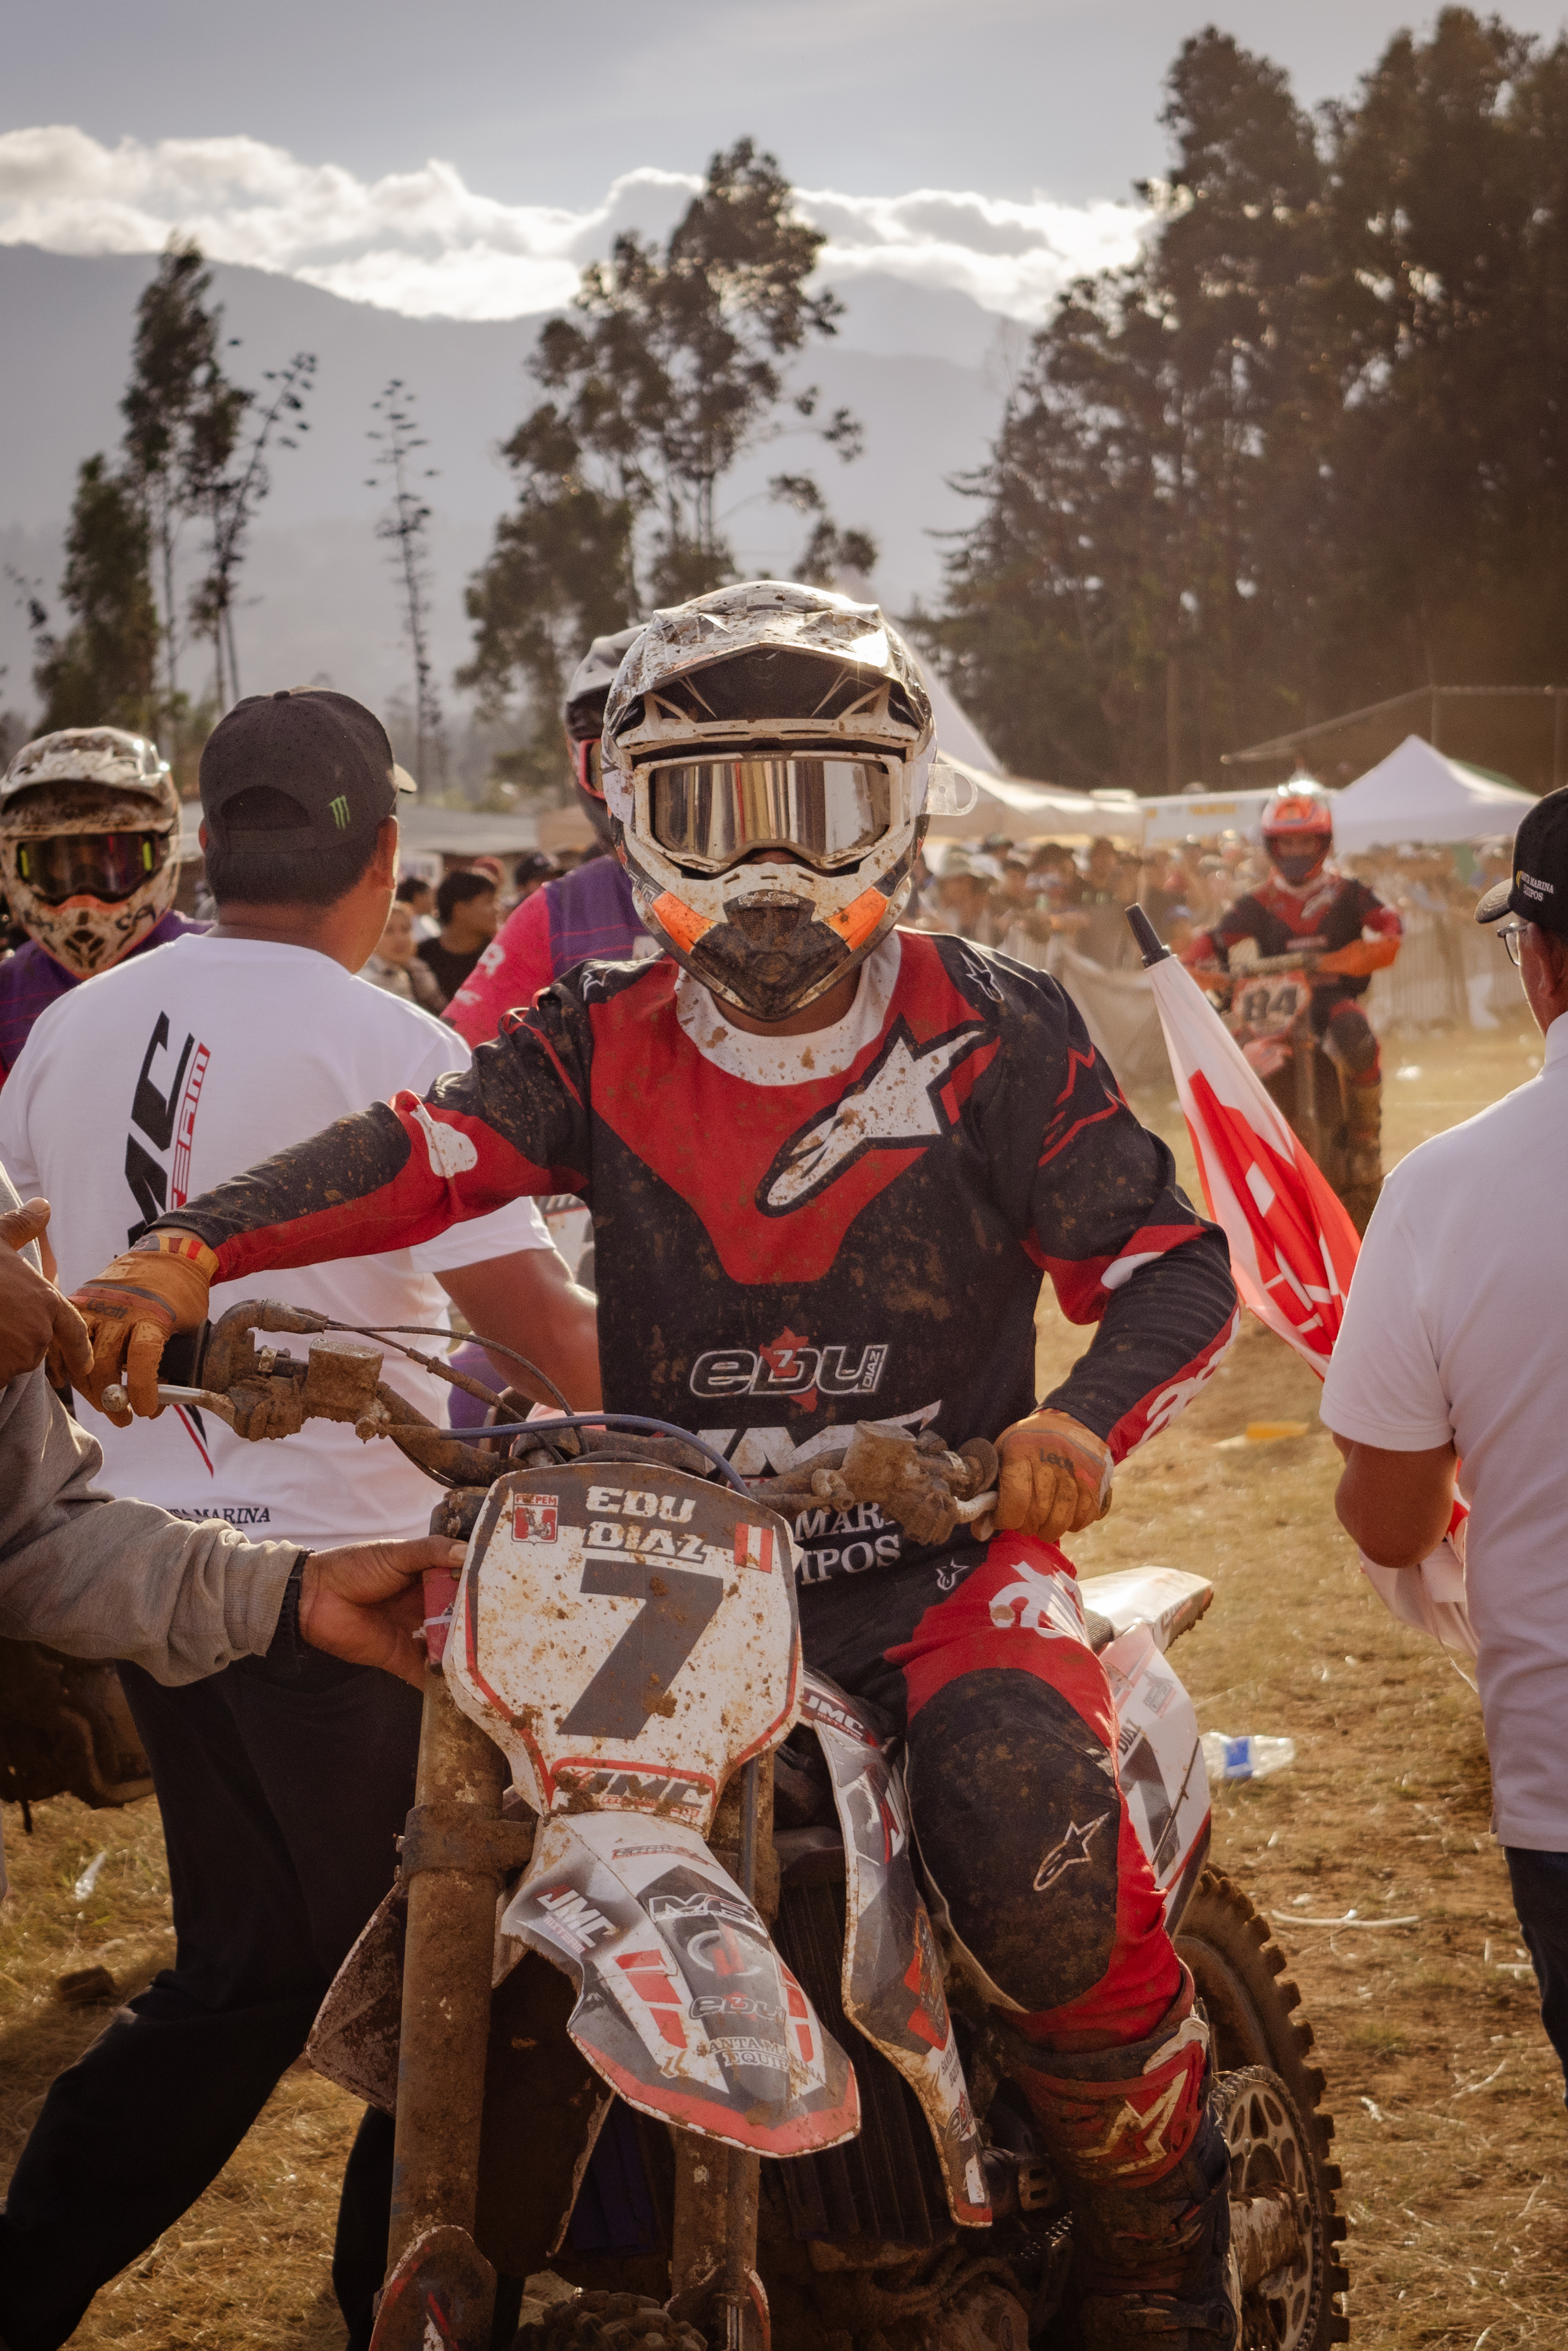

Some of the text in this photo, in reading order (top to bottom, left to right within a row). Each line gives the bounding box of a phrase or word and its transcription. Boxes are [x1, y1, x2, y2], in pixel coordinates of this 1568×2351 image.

[1530, 876, 1553, 894] MARINA
[862, 1350, 880, 1388] DIAZ
[586, 1485, 696, 1523] EDU
[794, 1502, 896, 1541] MAR
[587, 1521, 705, 1561] DIAZ
[800, 1535, 901, 1585] IPOS
[556, 1558, 724, 1741] 7
[804, 1694, 864, 1737] JMC
[536, 1888, 618, 1948] JMC
[725, 2051, 809, 2086] EQUIP
